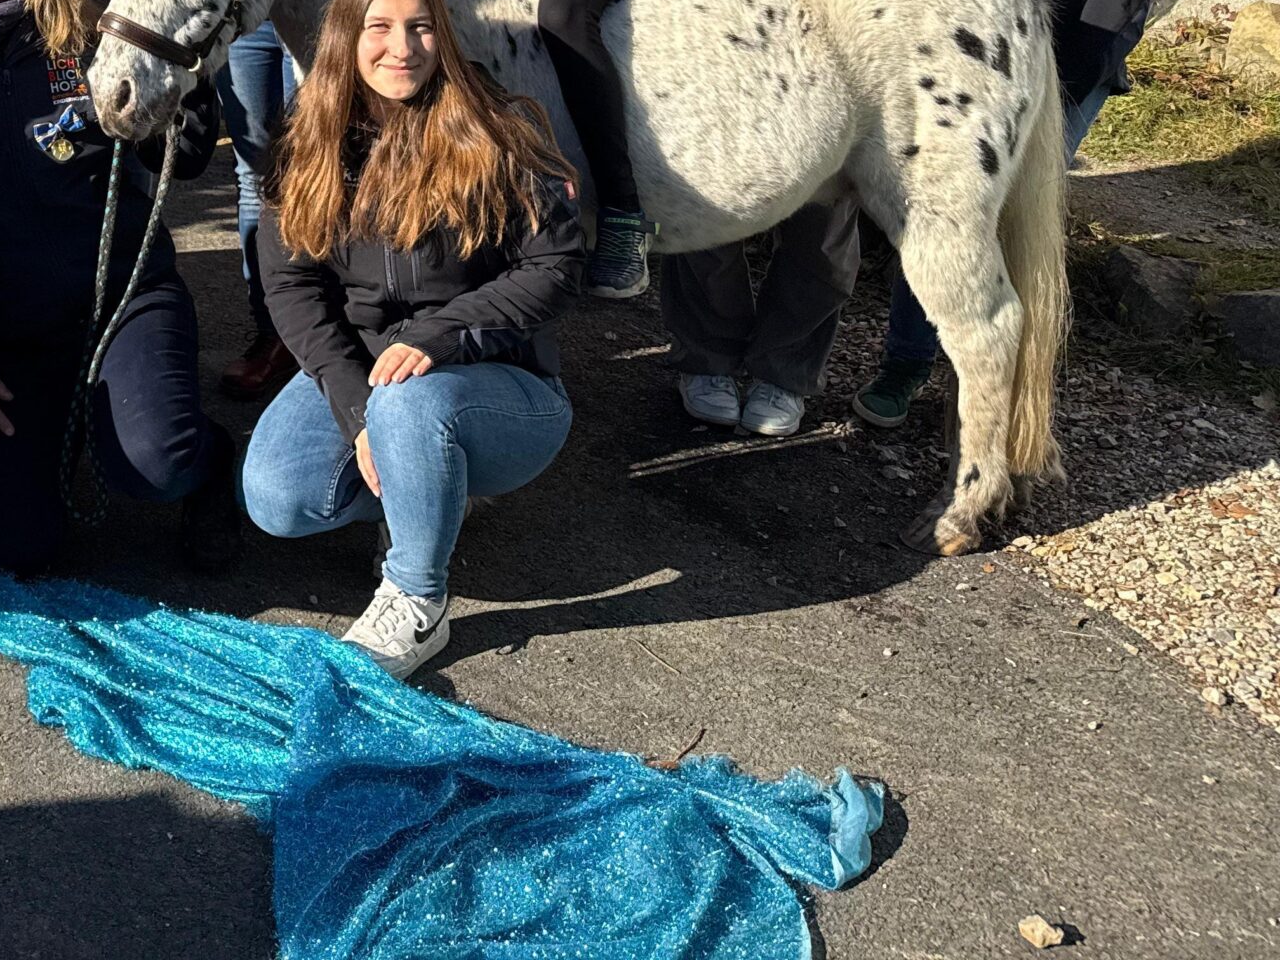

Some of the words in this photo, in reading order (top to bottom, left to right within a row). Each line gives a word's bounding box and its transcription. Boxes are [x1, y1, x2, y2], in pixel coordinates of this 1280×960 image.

[46, 57, 81, 70] LICHT
[48, 69, 83, 81] BLICK
[50, 80, 77, 93] HOF
